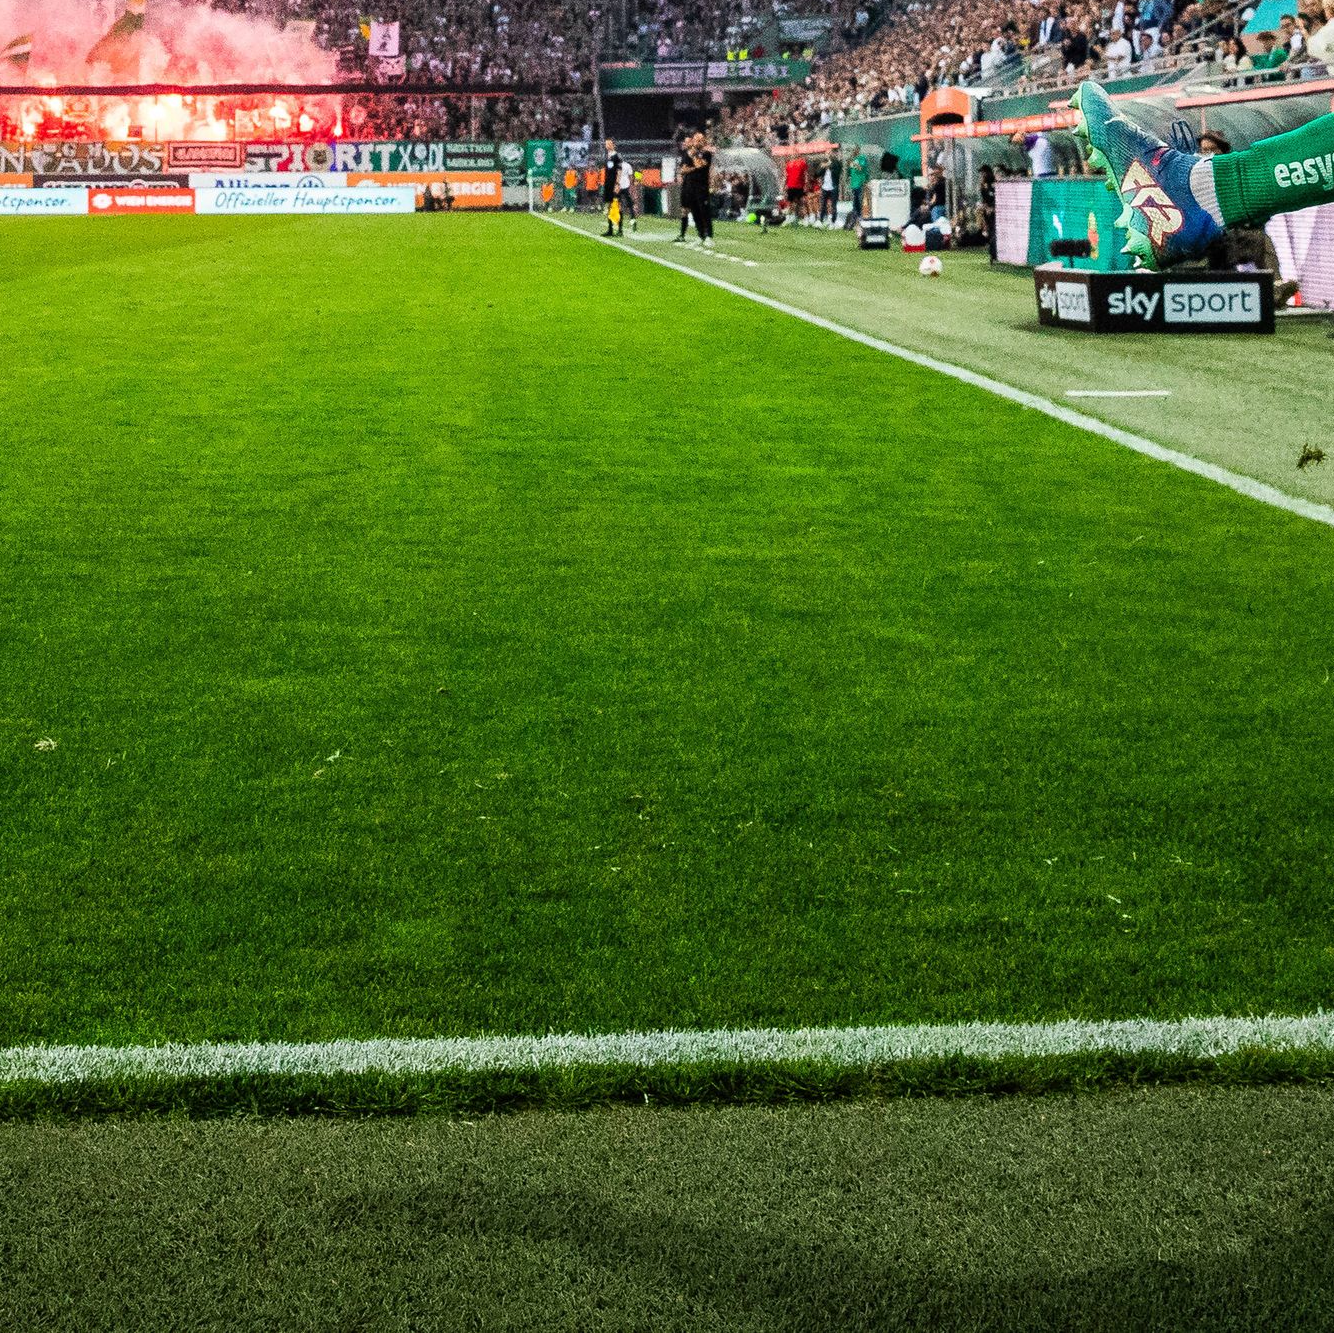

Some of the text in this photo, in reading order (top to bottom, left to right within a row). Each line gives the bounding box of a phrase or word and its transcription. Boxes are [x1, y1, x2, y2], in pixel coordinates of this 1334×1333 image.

[214, 191, 402, 211] Offizieller Hauptsponsor.
[1107, 285, 1253, 321] sky sport
